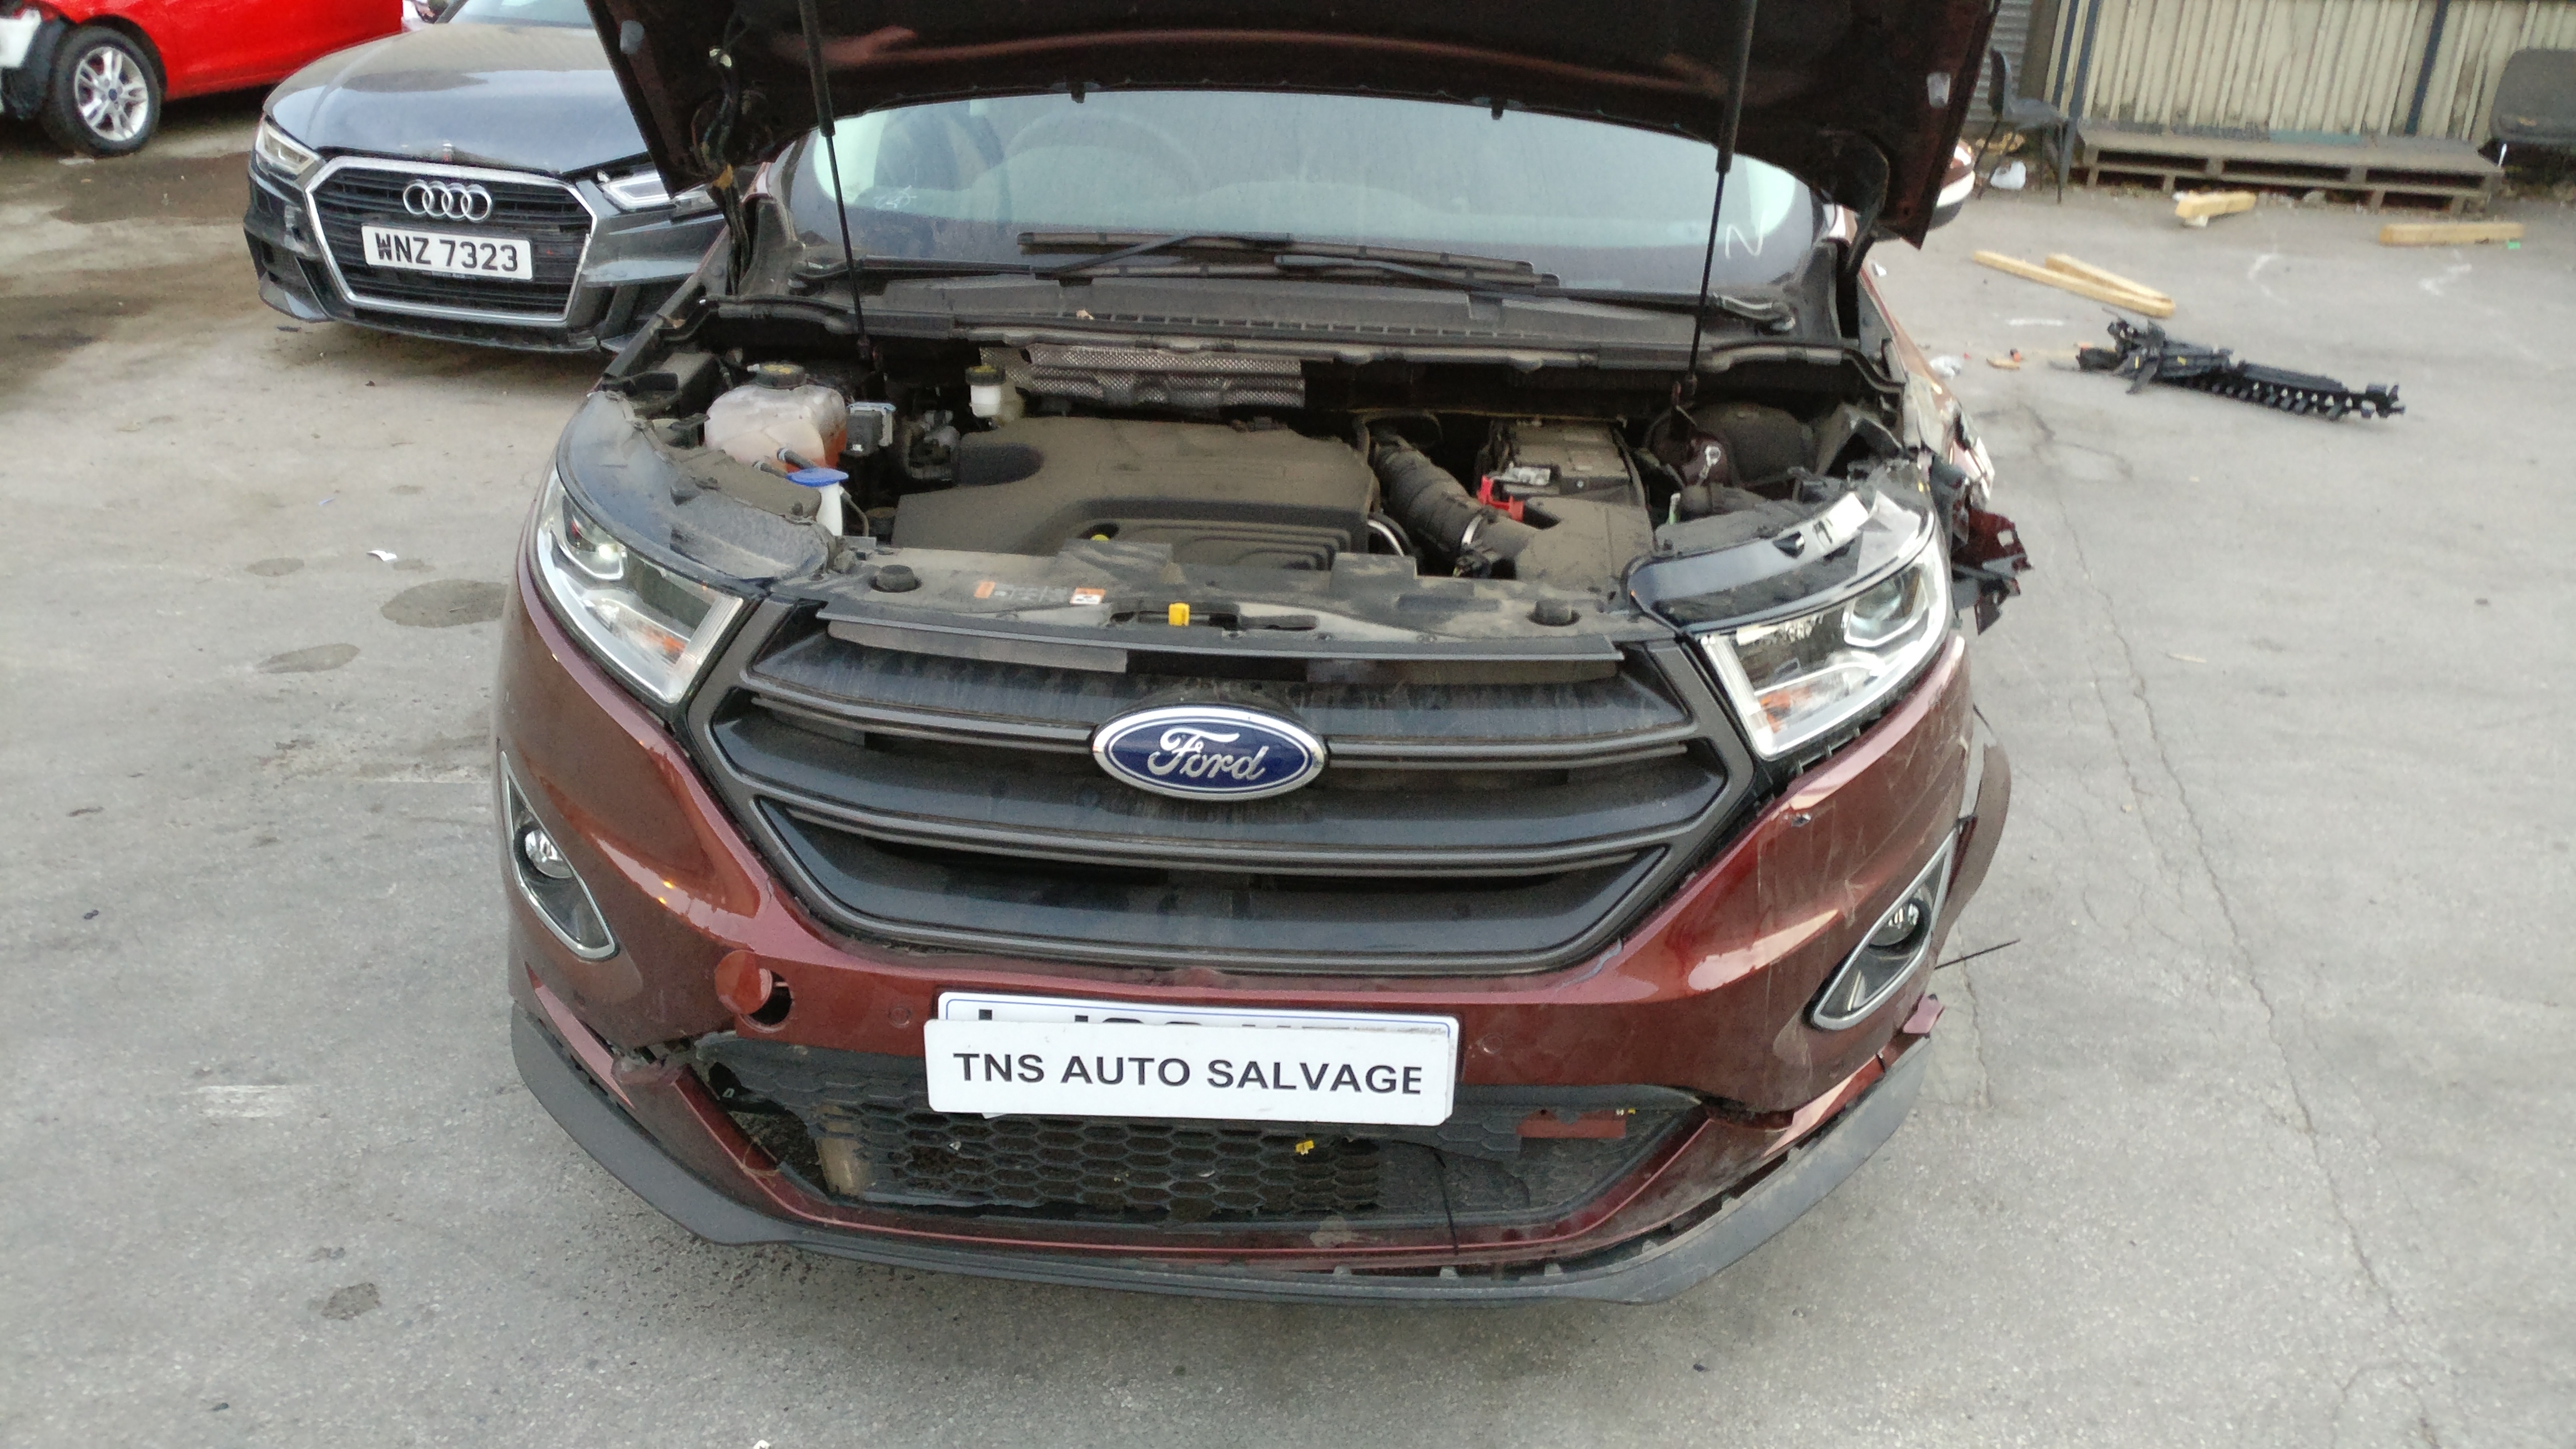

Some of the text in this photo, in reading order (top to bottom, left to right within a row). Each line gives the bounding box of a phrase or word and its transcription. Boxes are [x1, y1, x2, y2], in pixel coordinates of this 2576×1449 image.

[375, 233, 518, 272] WNZ 7323
[1148, 727, 1270, 781] Ford
[953, 1053, 1422, 1094] TNS AUTO SALVAGE
